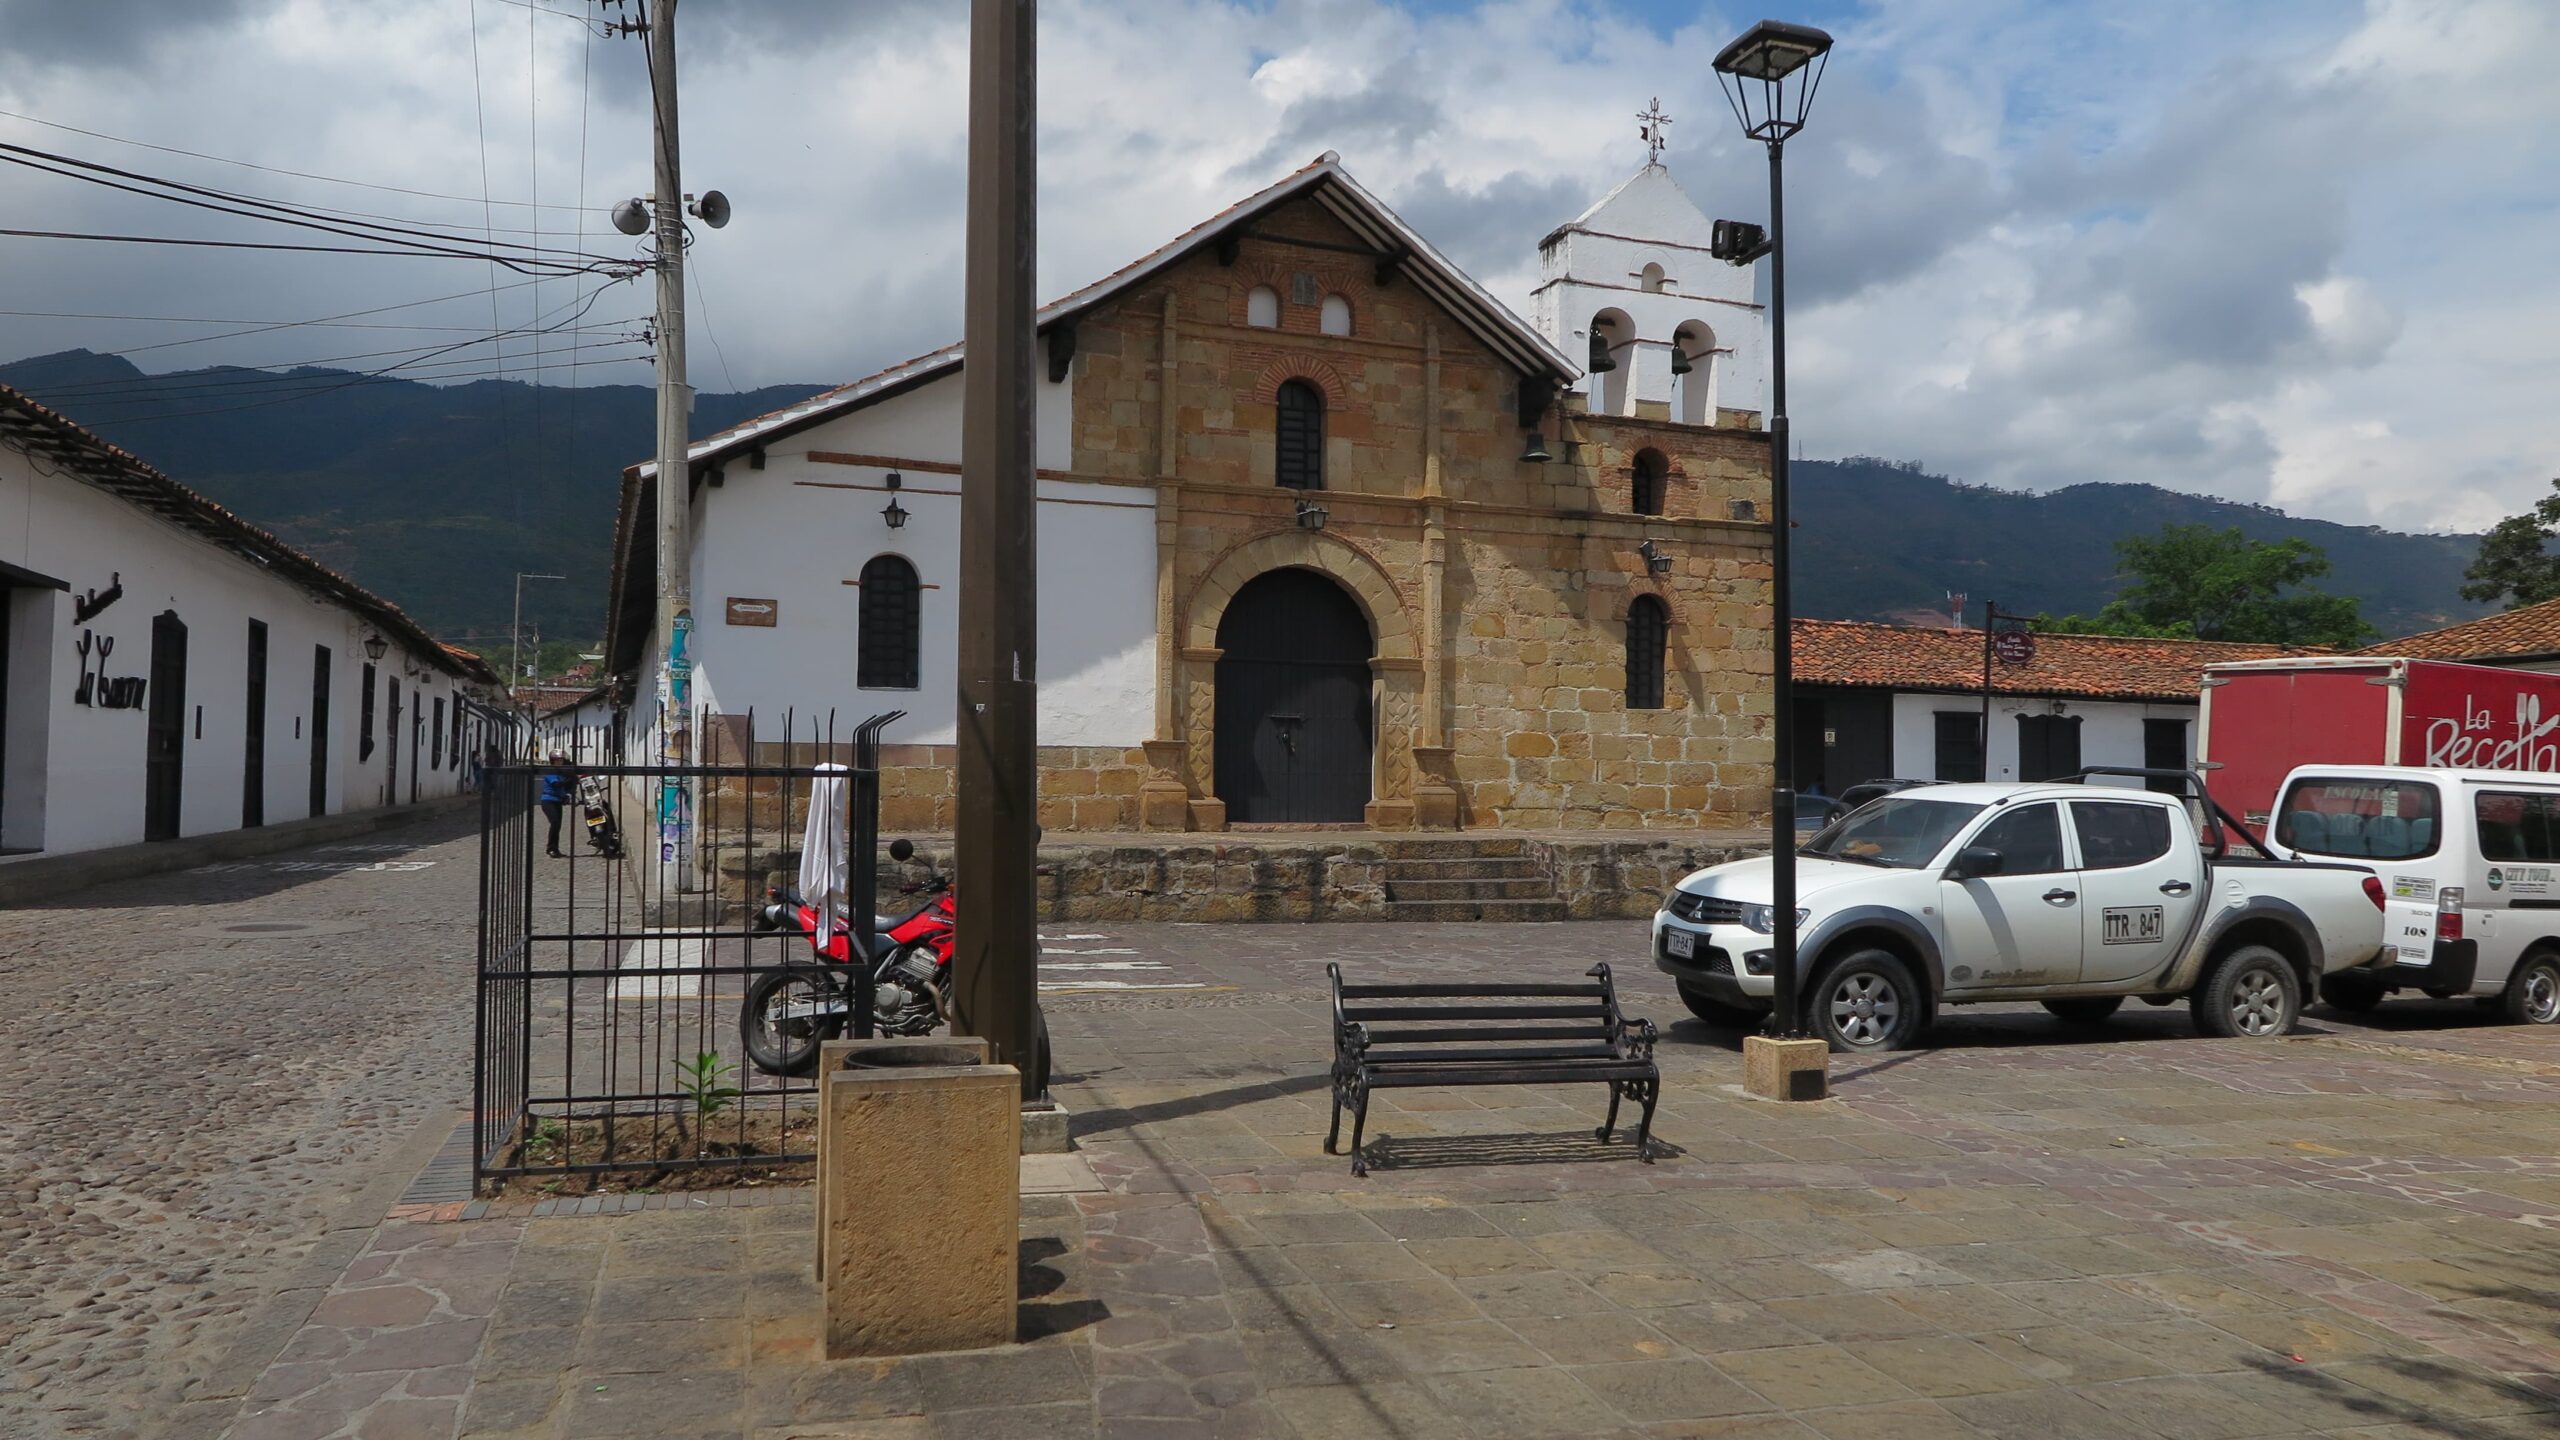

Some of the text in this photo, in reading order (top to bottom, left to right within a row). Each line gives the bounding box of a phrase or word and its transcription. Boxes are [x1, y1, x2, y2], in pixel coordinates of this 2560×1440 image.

[2465, 694, 2491, 730] La
[2323, 786, 2386, 800] ESCOLA
[2106, 912, 2160, 937] TTR 847
